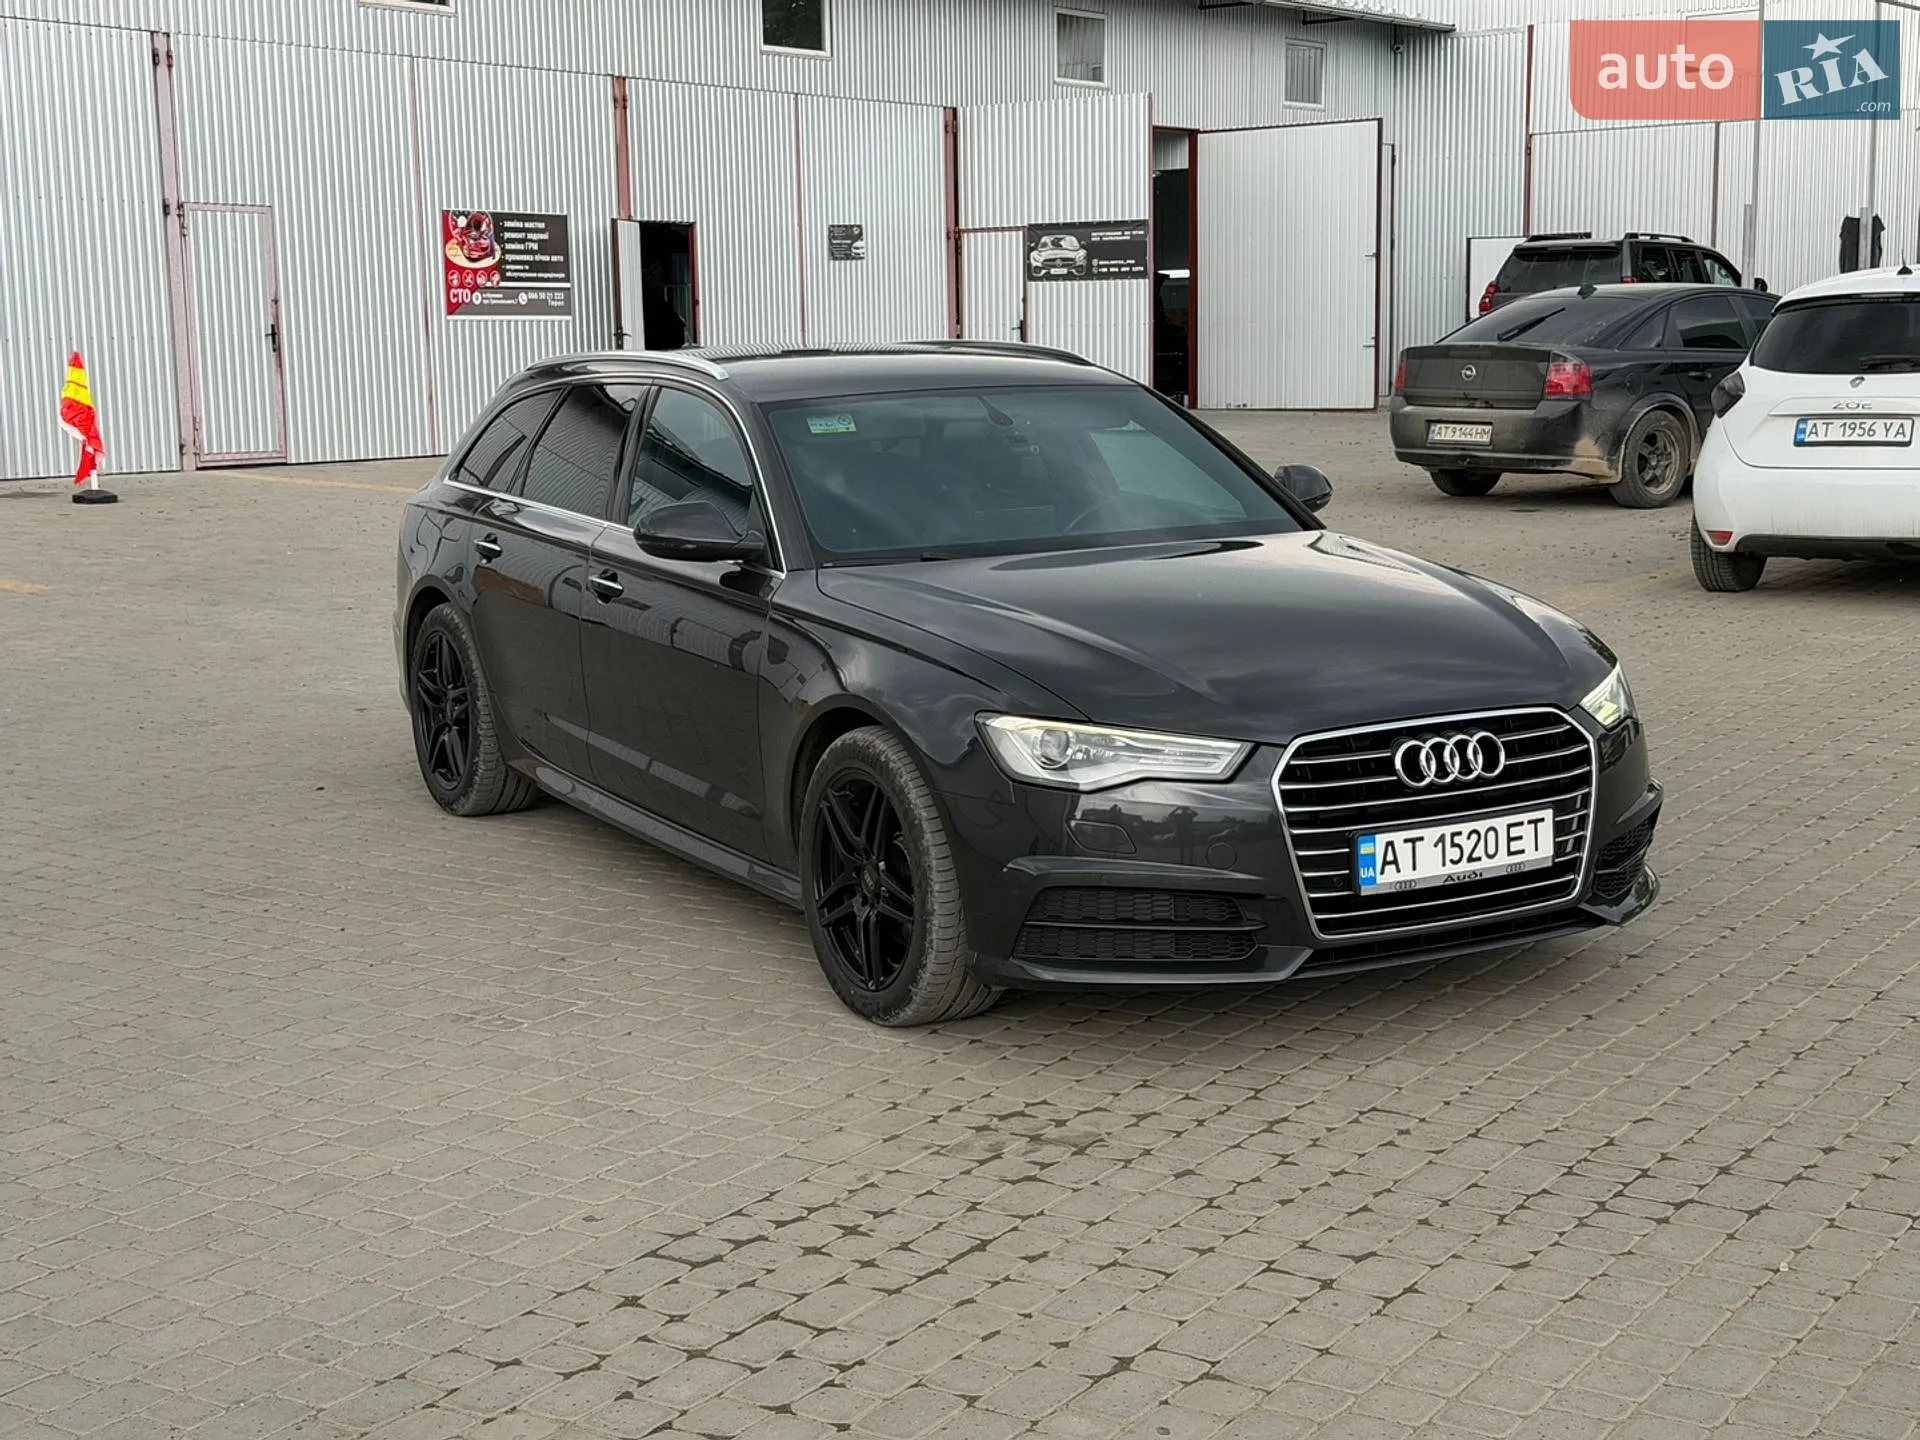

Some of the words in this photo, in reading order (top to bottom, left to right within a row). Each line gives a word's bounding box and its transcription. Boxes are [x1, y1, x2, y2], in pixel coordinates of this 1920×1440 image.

[449, 288, 471, 304] СТО
[1807, 421, 1834, 438] AT
[1838, 421, 1878, 438] 1956
[1883, 421, 1906, 439] YA
[1379, 835, 1425, 877] AT
[1432, 826, 1500, 868] 1520
[1506, 817, 1546, 858] ET
[1360, 866, 1375, 879] UA
[1442, 870, 1484, 884] Audi
